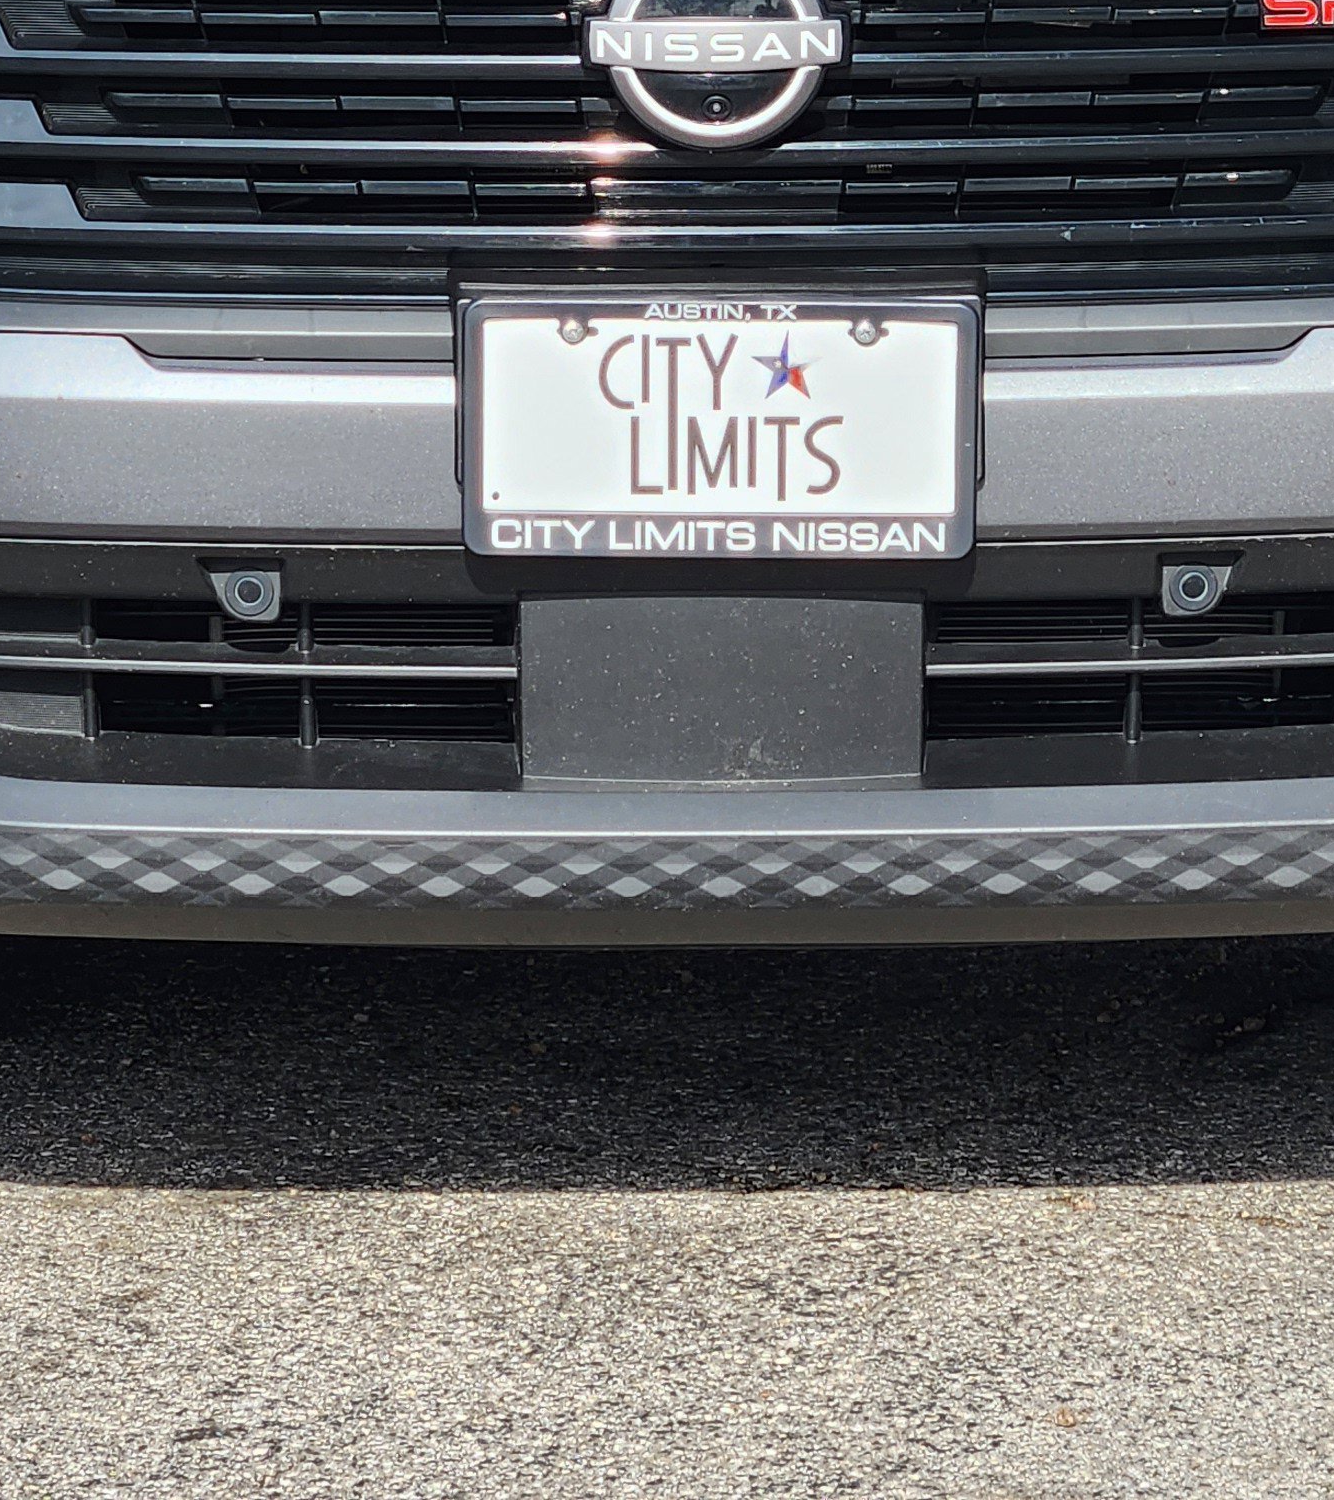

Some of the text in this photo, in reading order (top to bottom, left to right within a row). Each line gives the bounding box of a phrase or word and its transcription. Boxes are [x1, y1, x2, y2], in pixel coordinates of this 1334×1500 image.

[595, 27, 838, 63] NISSAN
[643, 303, 798, 322] AUSTIN, TX
[598, 332, 739, 412] CITY
[629, 415, 844, 501] LIMITS
[490, 520, 946, 552] CITY LIMITS NISSAN
